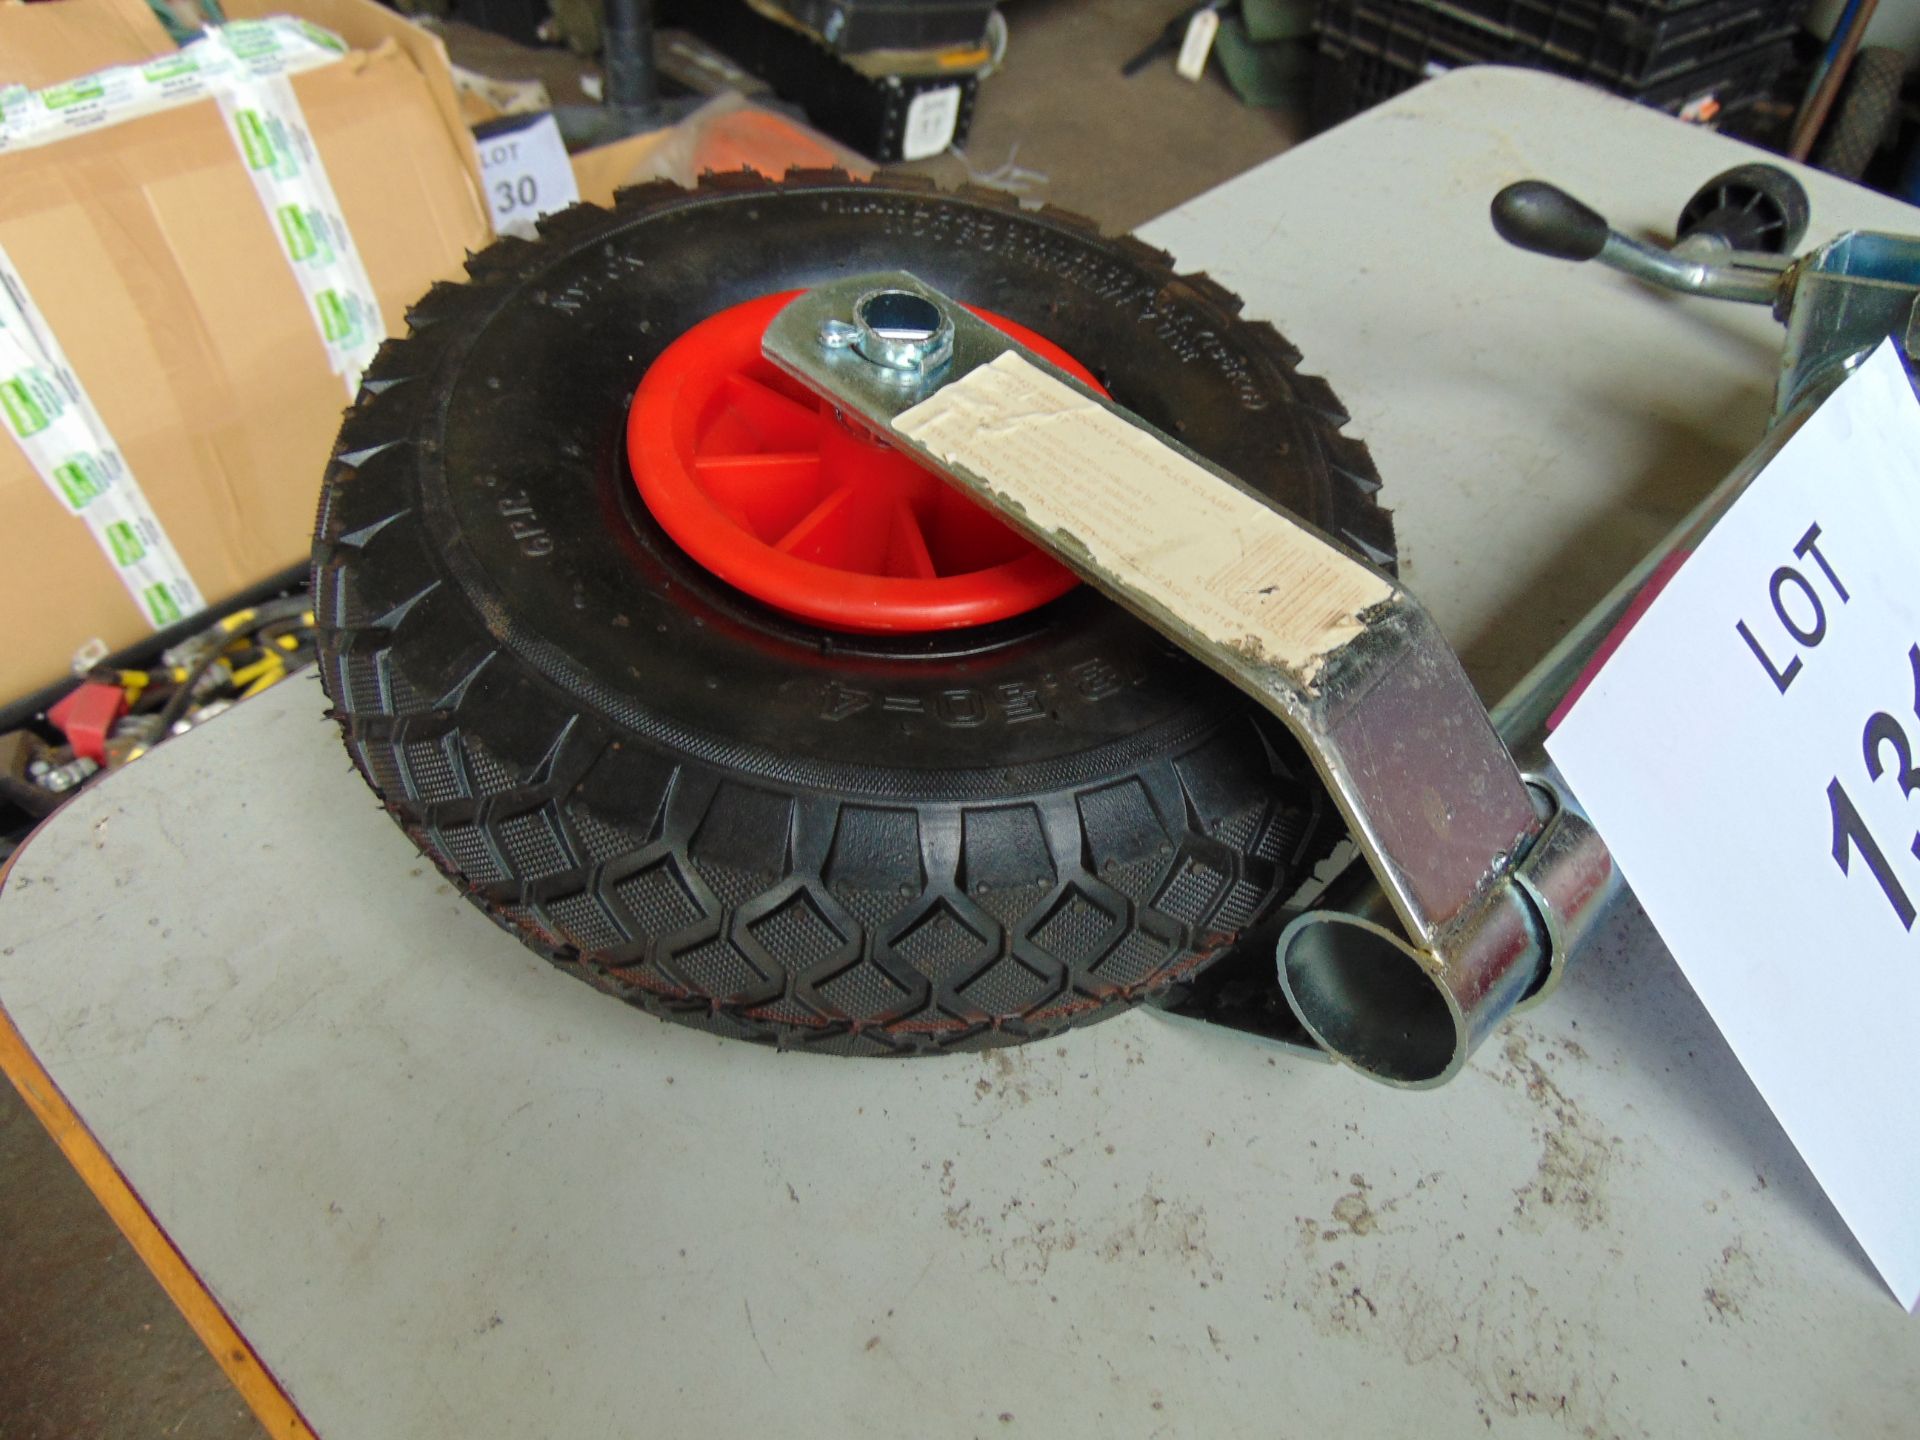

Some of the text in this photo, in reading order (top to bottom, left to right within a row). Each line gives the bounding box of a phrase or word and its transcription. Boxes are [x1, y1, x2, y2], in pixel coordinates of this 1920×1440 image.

[480, 142, 519, 169] LOT
[495, 174, 538, 214] 30
[1735, 520, 1850, 696] LOT
